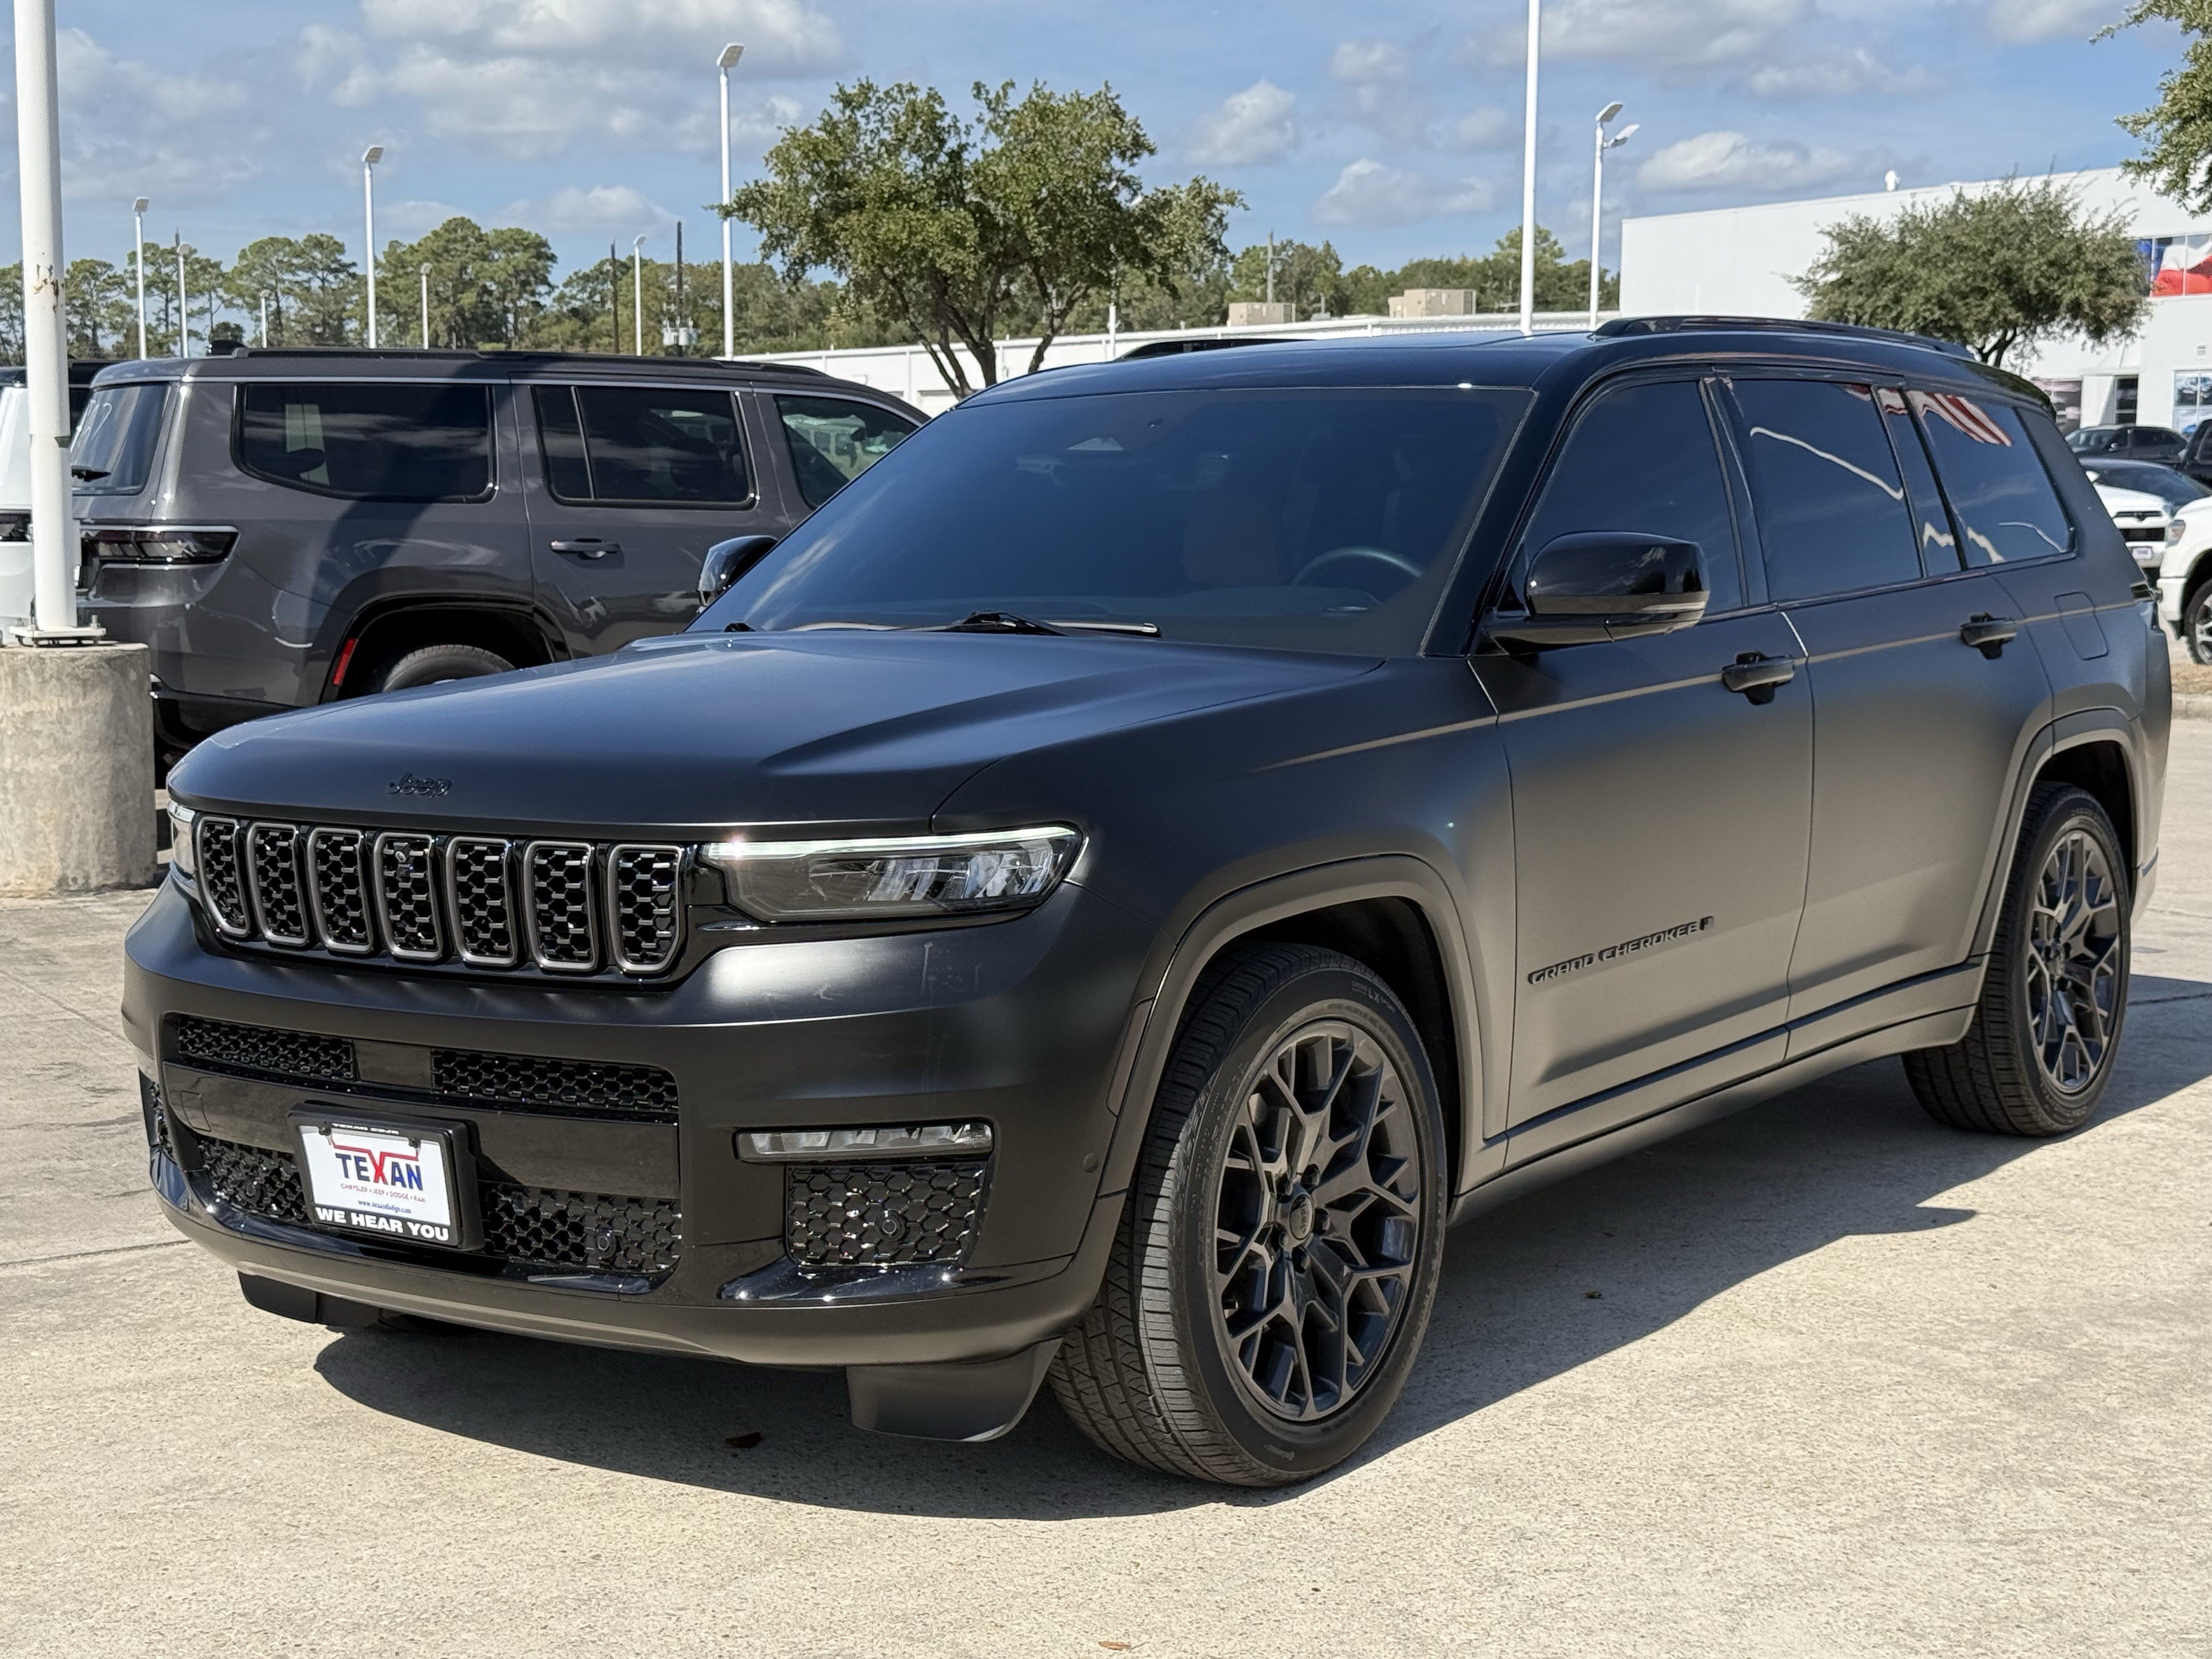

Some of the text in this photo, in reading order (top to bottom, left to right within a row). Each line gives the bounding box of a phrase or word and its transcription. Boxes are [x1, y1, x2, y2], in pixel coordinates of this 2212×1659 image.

[387, 772, 452, 799] Jeep
[1528, 953, 1595, 985] GRAND
[1598, 921, 1698, 962] CHEROKEE
[332, 1143, 424, 1191] TEXAN
[341, 1183, 368, 1193] CHRYSLER
[390, 1191, 409, 1200] DODGE
[414, 1195, 426, 1203] RAM
[315, 1207, 449, 1241] WE HEAR YOU
